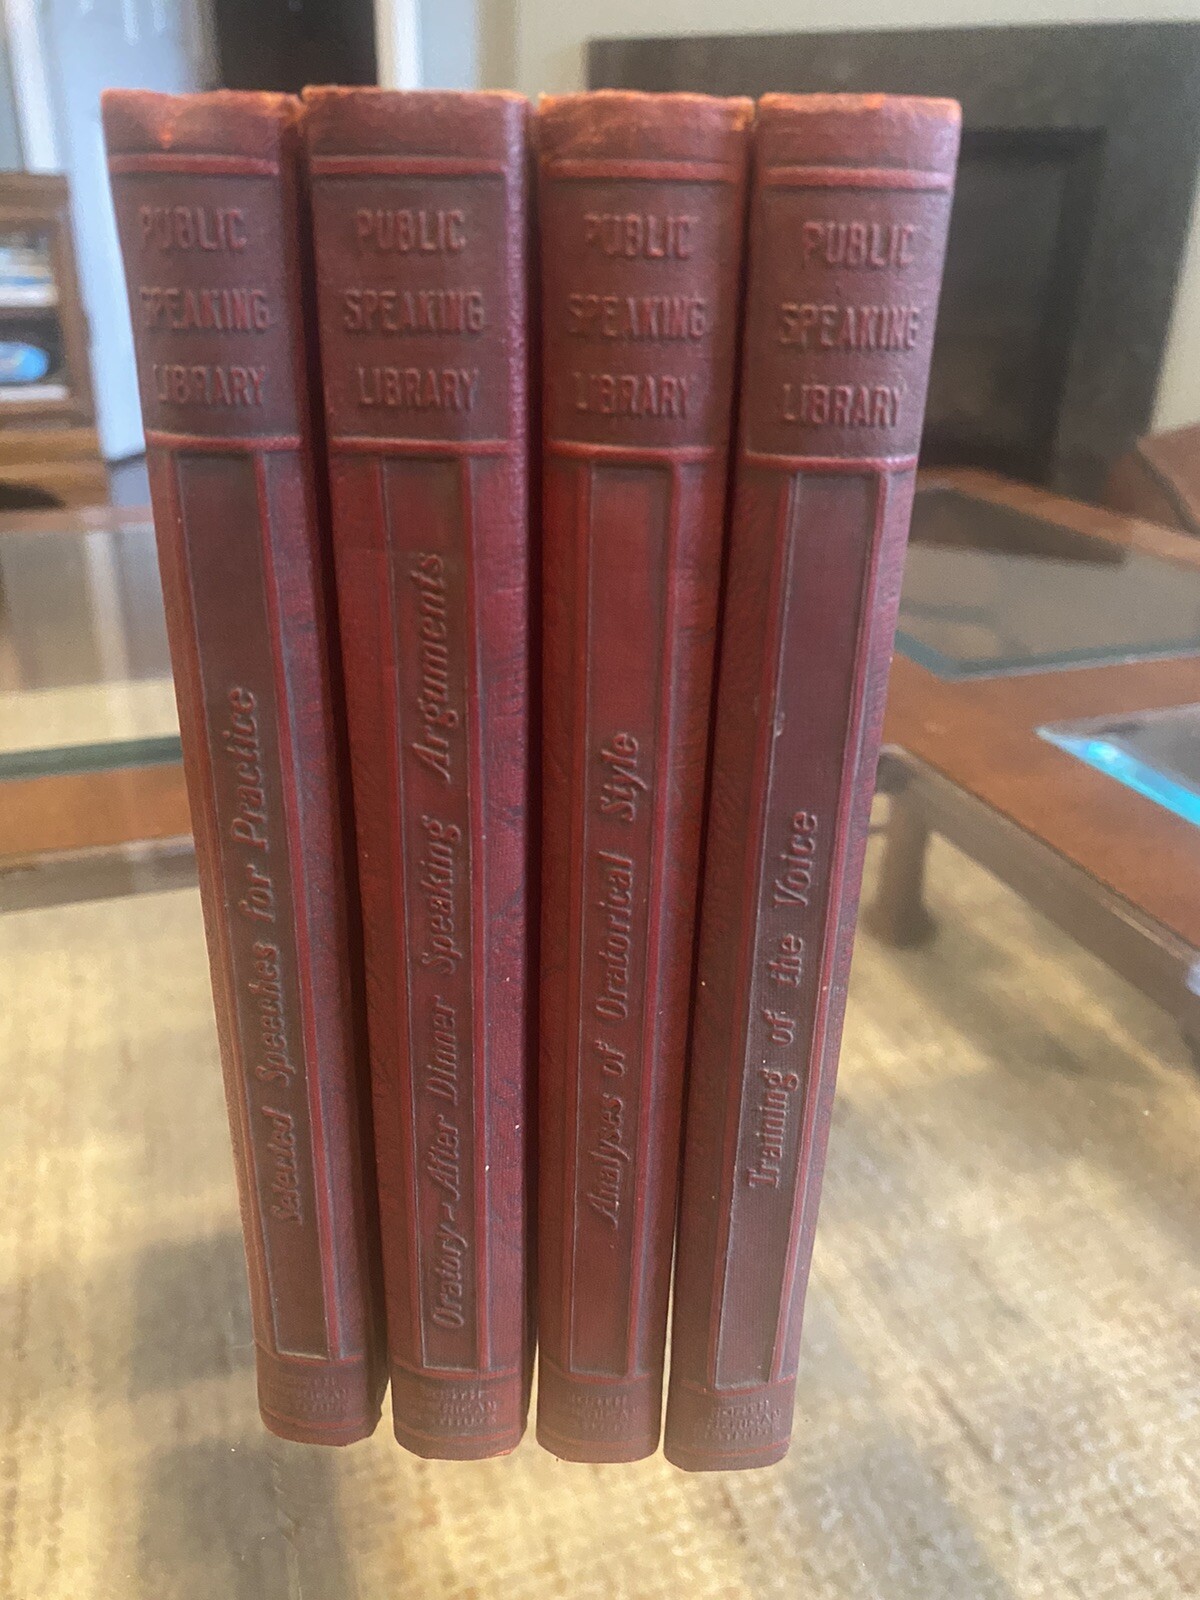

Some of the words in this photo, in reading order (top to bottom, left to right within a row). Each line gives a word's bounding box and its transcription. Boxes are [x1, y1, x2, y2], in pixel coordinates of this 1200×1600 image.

[355, 208, 467, 251] PUBLIC
[583, 212, 699, 259] PUBLIC
[802, 219, 921, 268] PUBLIC
[343, 288, 486, 332] SPEAKING
[567, 293, 707, 340] SPEAKING
[779, 301, 922, 350] SPEAKING
[357, 365, 481, 411] LIBRARY
[572, 371, 698, 416] LIBRARY
[782, 382, 908, 429] LIBRARY
[409, 552, 459, 784] Arguments
[223, 687, 268, 851] Practice
[599, 731, 648, 822] Style
[773, 811, 818, 908] Voice
[238, 864, 275, 923] for
[421, 814, 463, 976] Speaking
[596, 850, 634, 1021] Oratorical
[769, 933, 804, 988] the
[249, 940, 296, 1089] Speeches
[762, 1009, 795, 1047] of
[426, 994, 458, 1106] Dinner
[595, 1039, 625, 1078] of
[748, 1067, 800, 1189] Training
[261, 1106, 303, 1226] Selected
[586, 1092, 631, 1231] Analyses
